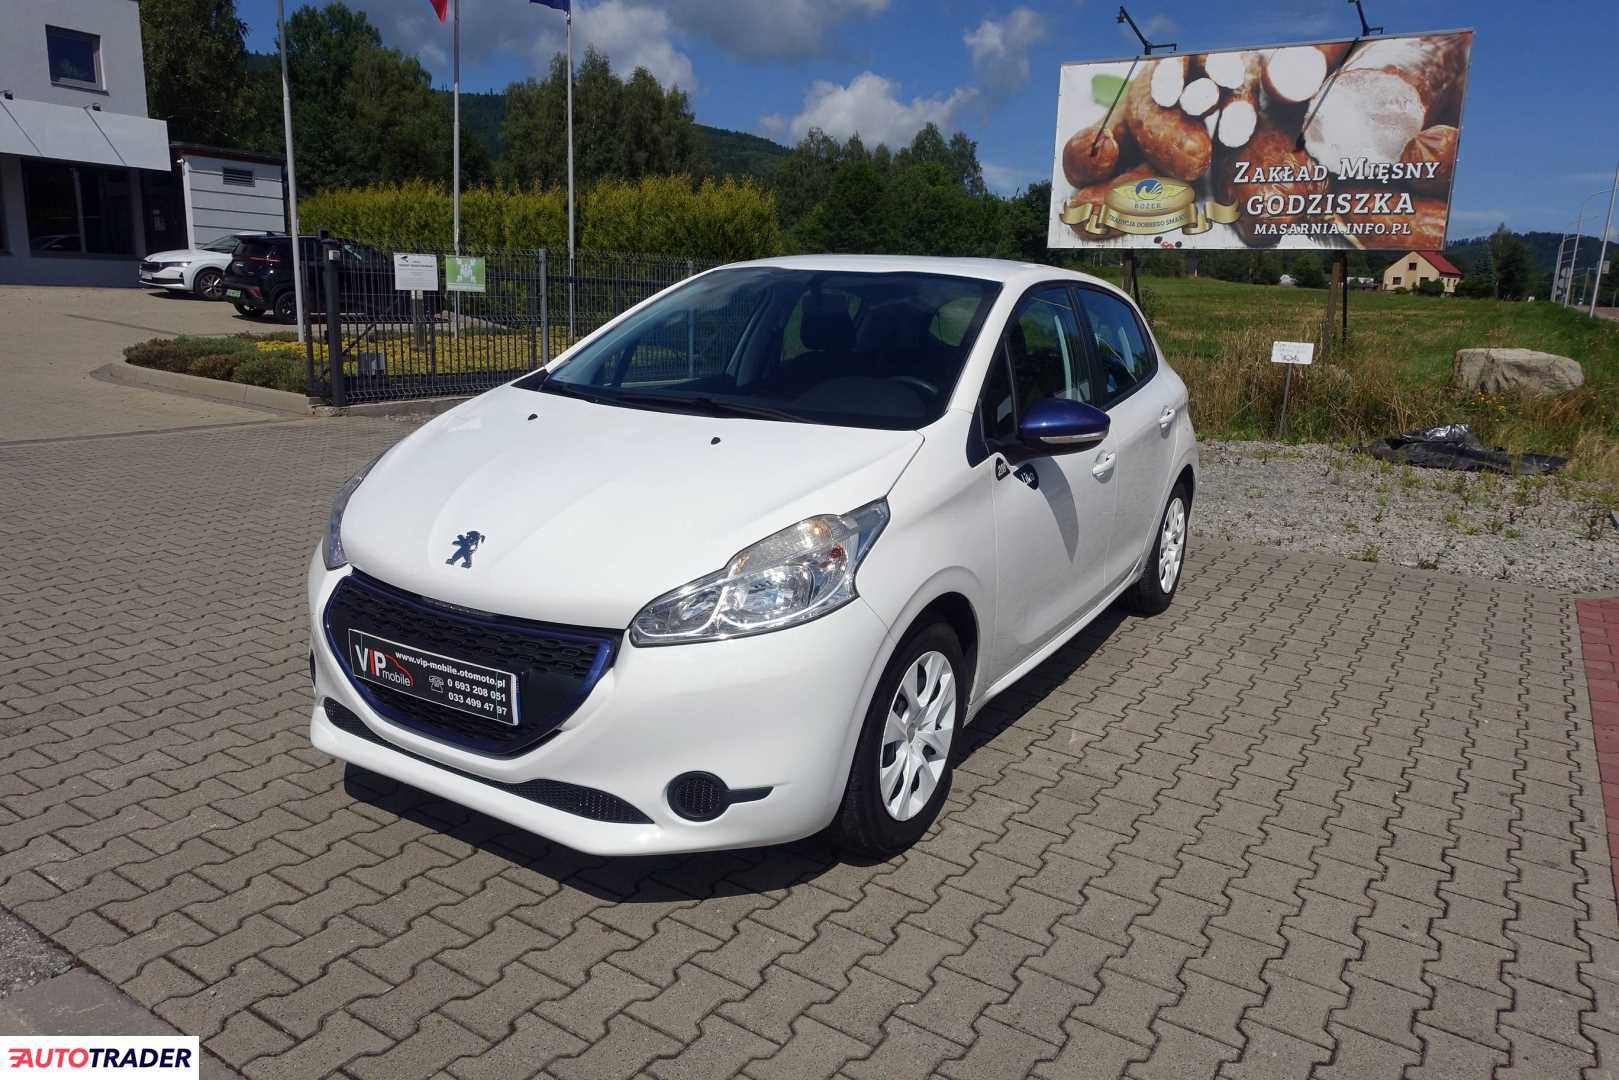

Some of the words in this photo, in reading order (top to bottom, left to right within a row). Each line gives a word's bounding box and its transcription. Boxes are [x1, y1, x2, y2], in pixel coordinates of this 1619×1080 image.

[1233, 161, 1328, 184] ZAKŁAD
[1337, 157, 1440, 184] MIĘSNY
[1246, 192, 1416, 216] GODZISZKA
[1254, 223, 1411, 235] MASARNIA.INFO.PL
[354, 644, 387, 677] VIP
[395, 651, 506, 688] www.vip-mobile.otomoto.pl
[382, 670, 411, 687] mobile
[454, 680, 471, 692] 693
[472, 685, 488, 697] 208
[465, 697, 481, 708] 499
[483, 702, 494, 711] 47
